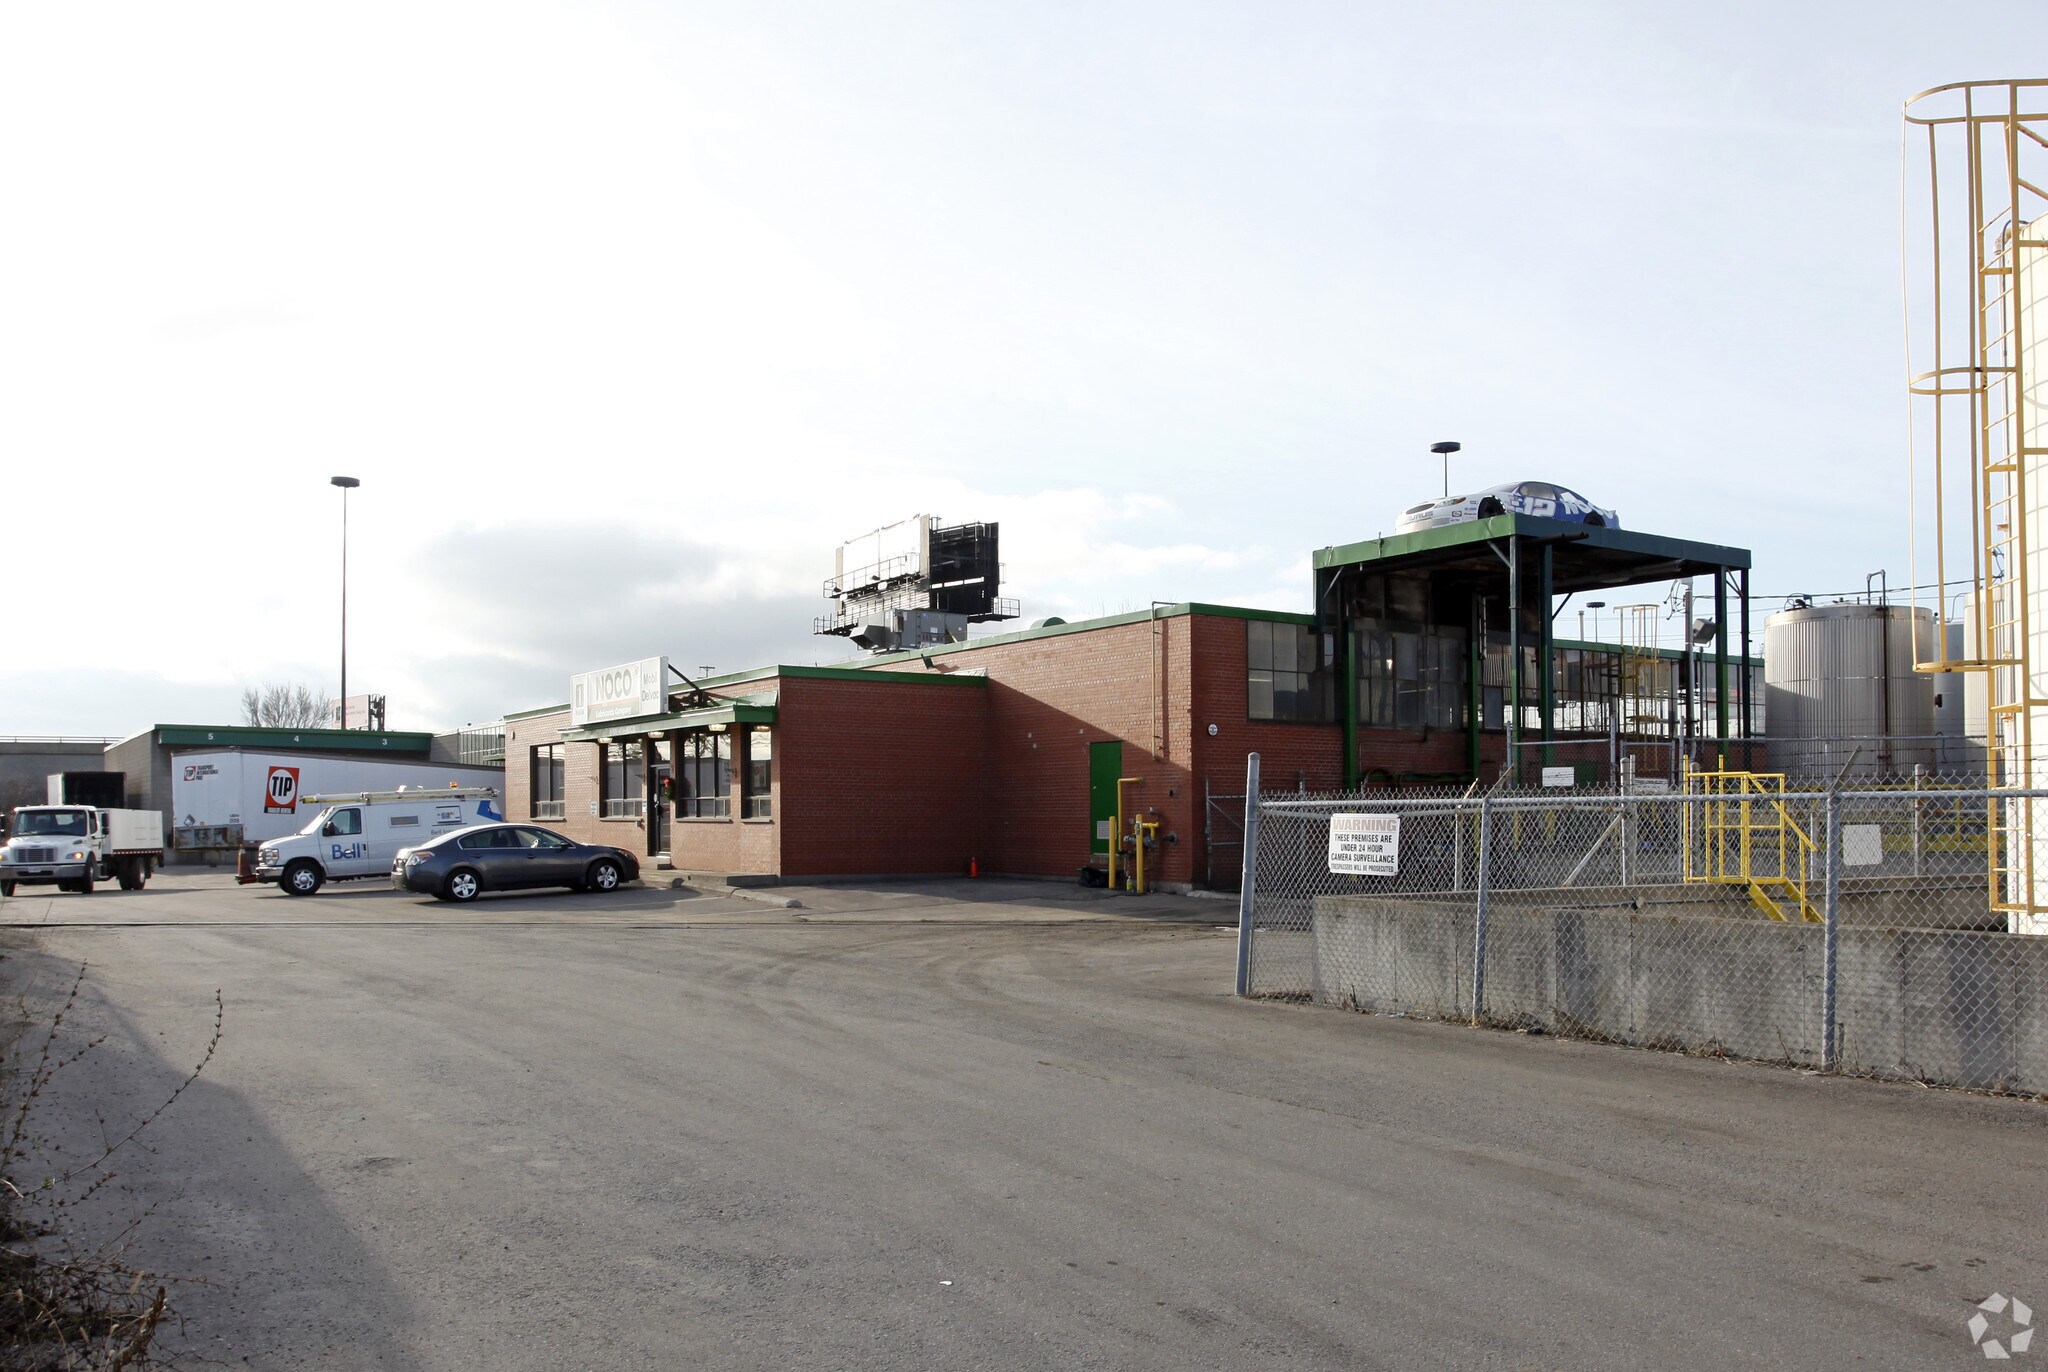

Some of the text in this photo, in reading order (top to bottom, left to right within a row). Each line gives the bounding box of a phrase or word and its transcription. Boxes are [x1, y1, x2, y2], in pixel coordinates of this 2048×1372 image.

[596, 669, 632, 701] NOCO
[382, 738, 388, 746] 3
[272, 776, 293, 796] TIP
[1333, 818, 1397, 832] WARNING
[1335, 833, 1392, 843] THESE PREMISES ARE
[332, 843, 361, 859] Bell
[1340, 843, 1383, 853] UNDER 24 HOUR
[1331, 852, 1395, 863] CAMERA SURVEILLANCE
[1368, 865, 1394, 873] PROSECUTED
